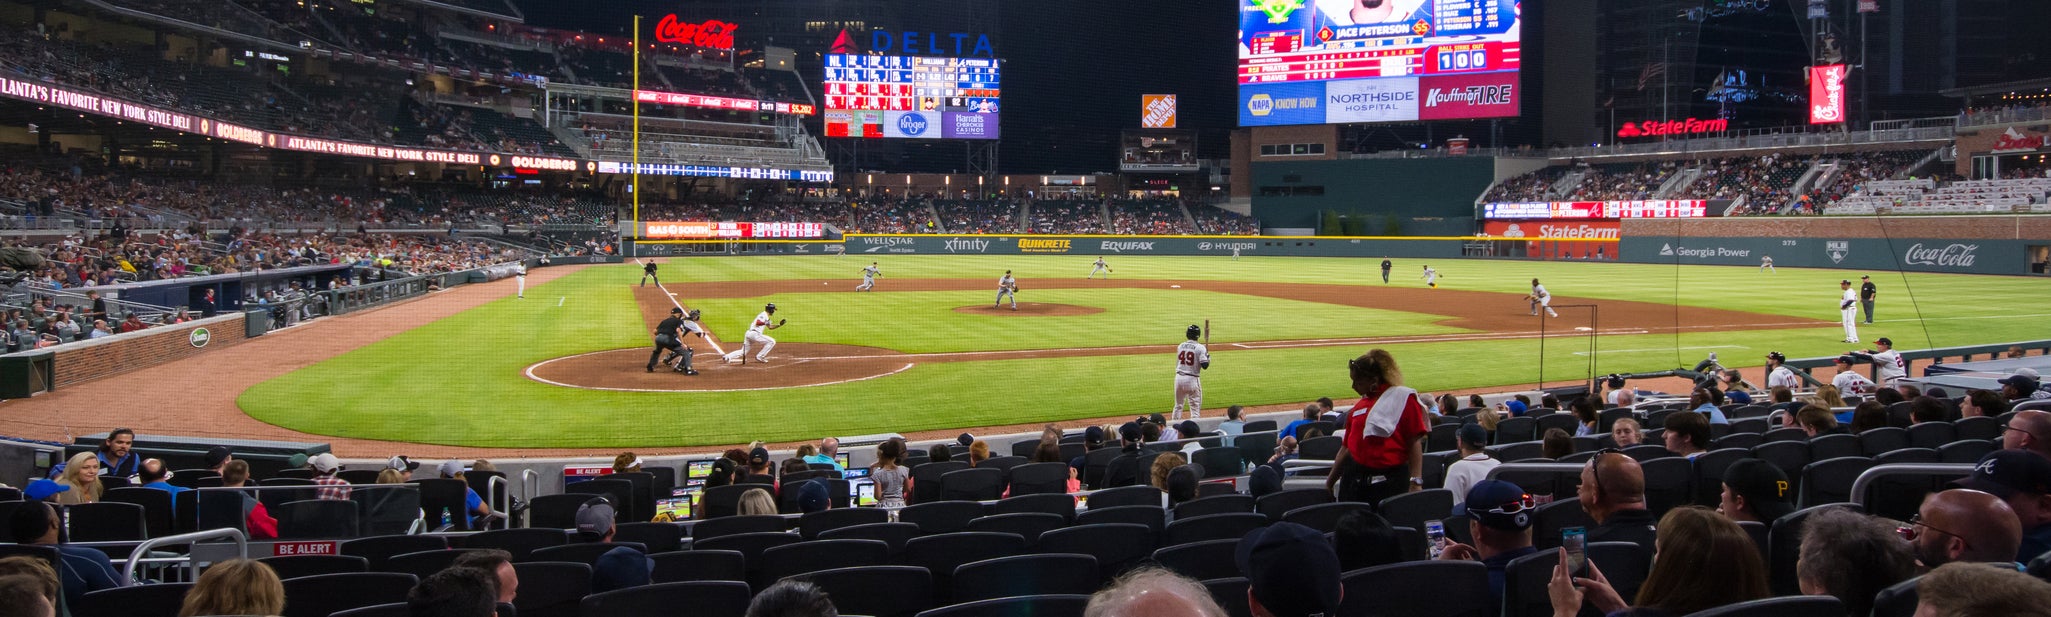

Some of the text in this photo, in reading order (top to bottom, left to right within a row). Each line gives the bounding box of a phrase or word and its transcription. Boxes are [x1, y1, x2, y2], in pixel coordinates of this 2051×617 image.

[655, 13, 738, 49] Coca-Cola
[1336, 28, 1358, 39] JACE
[1359, 24, 1410, 36] PETERSON
[1415, 22, 1427, 33] SS
[872, 30, 993, 55] DELTA
[829, 55, 841, 67] NL
[1441, 52, 1485, 68] 1 0 0
[1262, 74, 1287, 82] BRAVES
[829, 83, 842, 95] AL
[1425, 84, 1513, 107] Kauffman TIRE
[1145, 98, 1161, 112] THE
[1252, 97, 1317, 110] NAPA KNOW HOW
[1330, 91, 1415, 104] NORTHSIDE
[51, 88, 100, 111] FAVORITE
[101, 99, 122, 115] NEW
[123, 104, 146, 121] YORK
[148, 109, 172, 126] STYLE
[172, 115, 191, 129] DELI
[761, 102, 774, 111] 9:11
[1142, 95, 1176, 127] HOME
[1345, 103, 1399, 112] HOSPITAL
[900, 116, 925, 133] Kroger
[955, 113, 985, 123] Harrah's
[1155, 107, 1176, 127] DEPOT
[216, 122, 263, 146] GOLDBERGS
[1993, 133, 2043, 150] Coors
[288, 138, 480, 164] ATLANTA'S FAVORITE NEW YORK STYLE DELI
[511, 155, 577, 171] GOLDBERGS
[648, 224, 708, 237] GAS SOUTH
[863, 237, 914, 247] WELLSTAR
[944, 237, 990, 254] xfinity
[1017, 238, 1072, 249] QUIKRETE
[1100, 240, 1156, 252] EQUIFAX
[1676, 247, 1751, 258] Georgia Power
[1905, 243, 1979, 266] Coca-Cola
[1178, 350, 1195, 366] 49
[1776, 480, 1788, 497] P
[279, 543, 331, 554] BE ALERT
